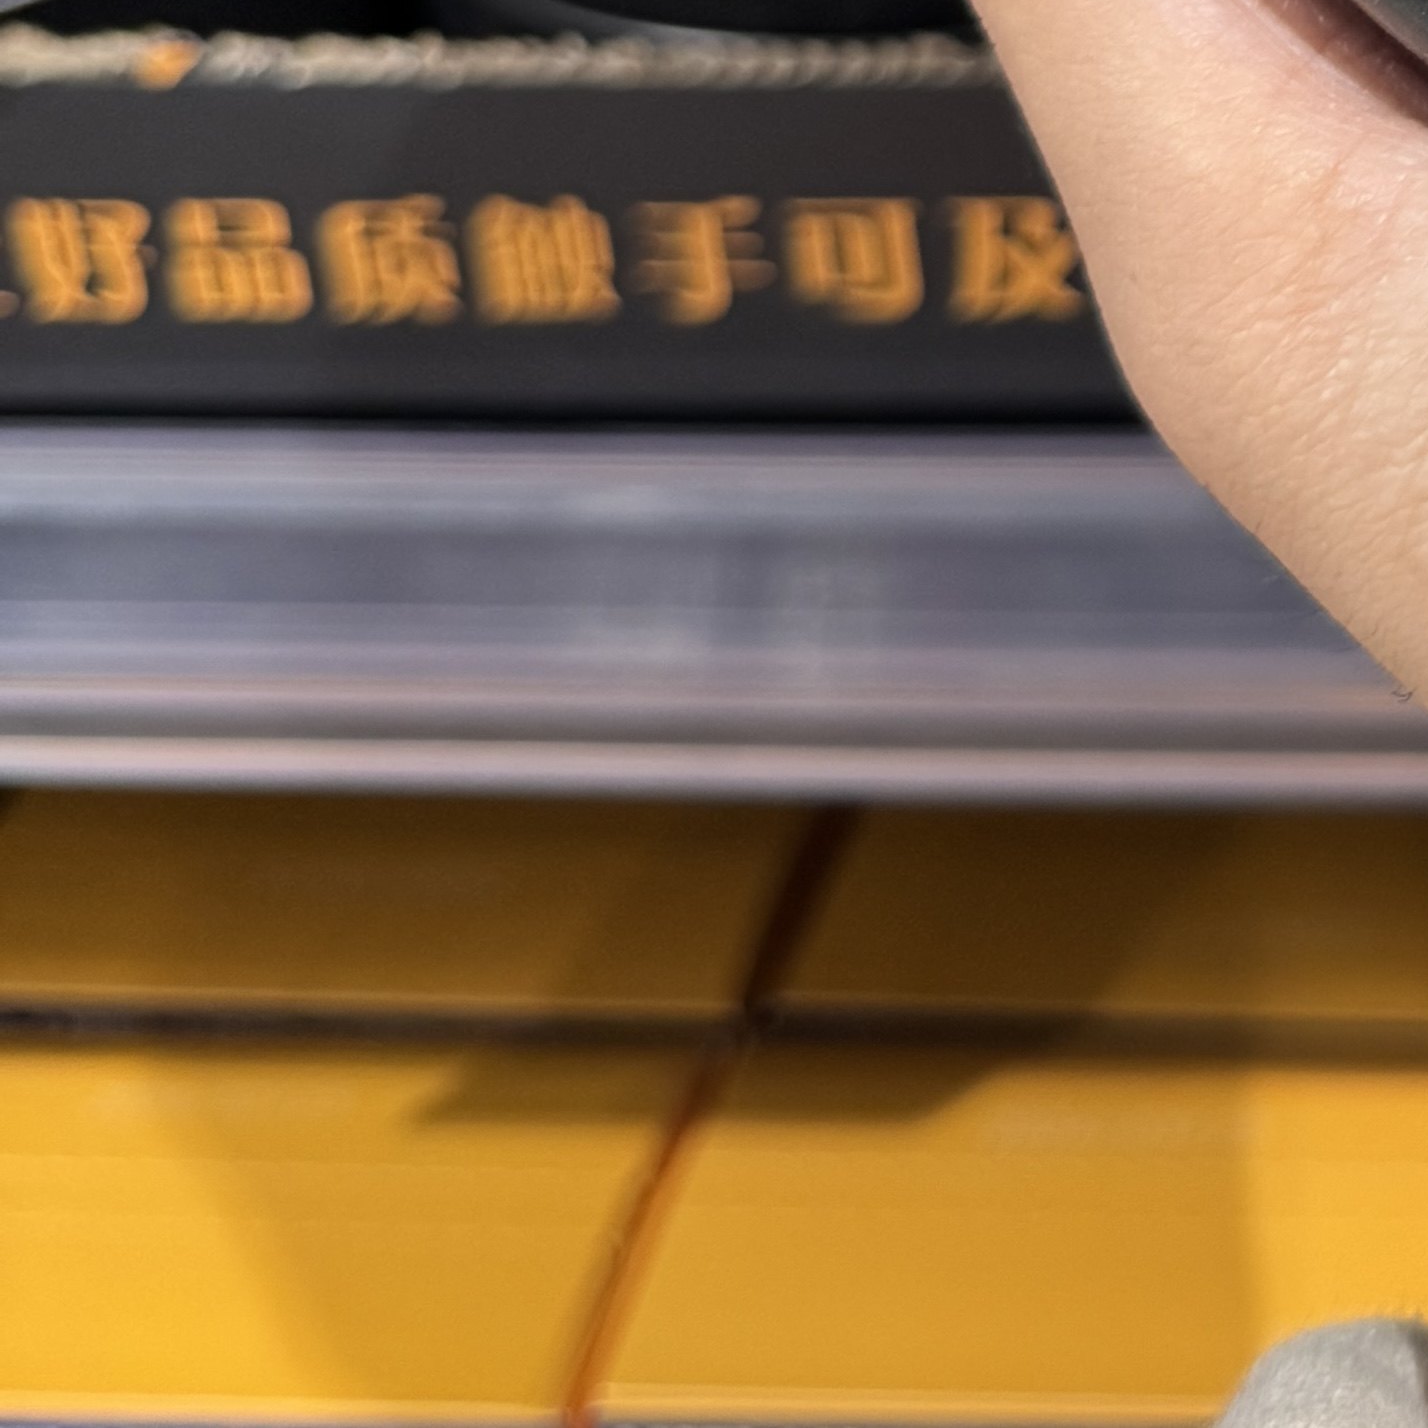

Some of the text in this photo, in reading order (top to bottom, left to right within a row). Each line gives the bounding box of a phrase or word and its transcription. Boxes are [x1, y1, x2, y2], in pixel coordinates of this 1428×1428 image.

[2, 194, 1087, 325] 好品质触手可及
